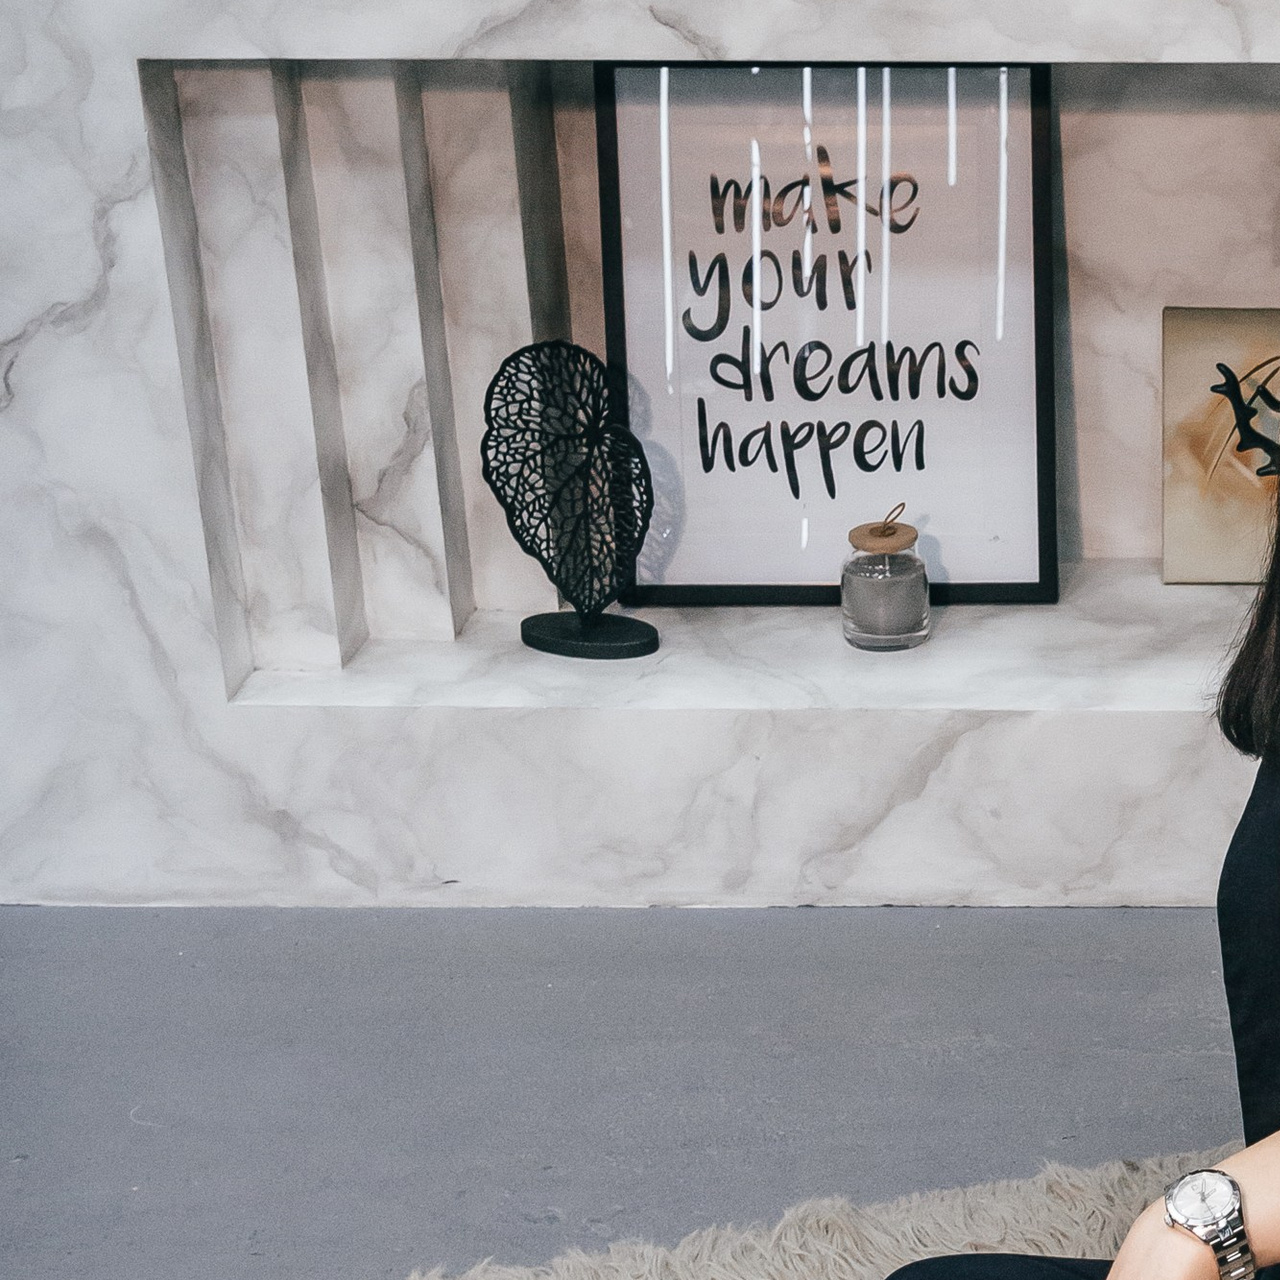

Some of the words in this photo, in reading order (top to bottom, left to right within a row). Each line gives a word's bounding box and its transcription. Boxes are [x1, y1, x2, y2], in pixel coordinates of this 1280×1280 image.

[709, 145, 920, 235] make
[682, 249, 872, 342] your
[709, 325, 981, 402] dreams
[697, 397, 926, 500] happen
